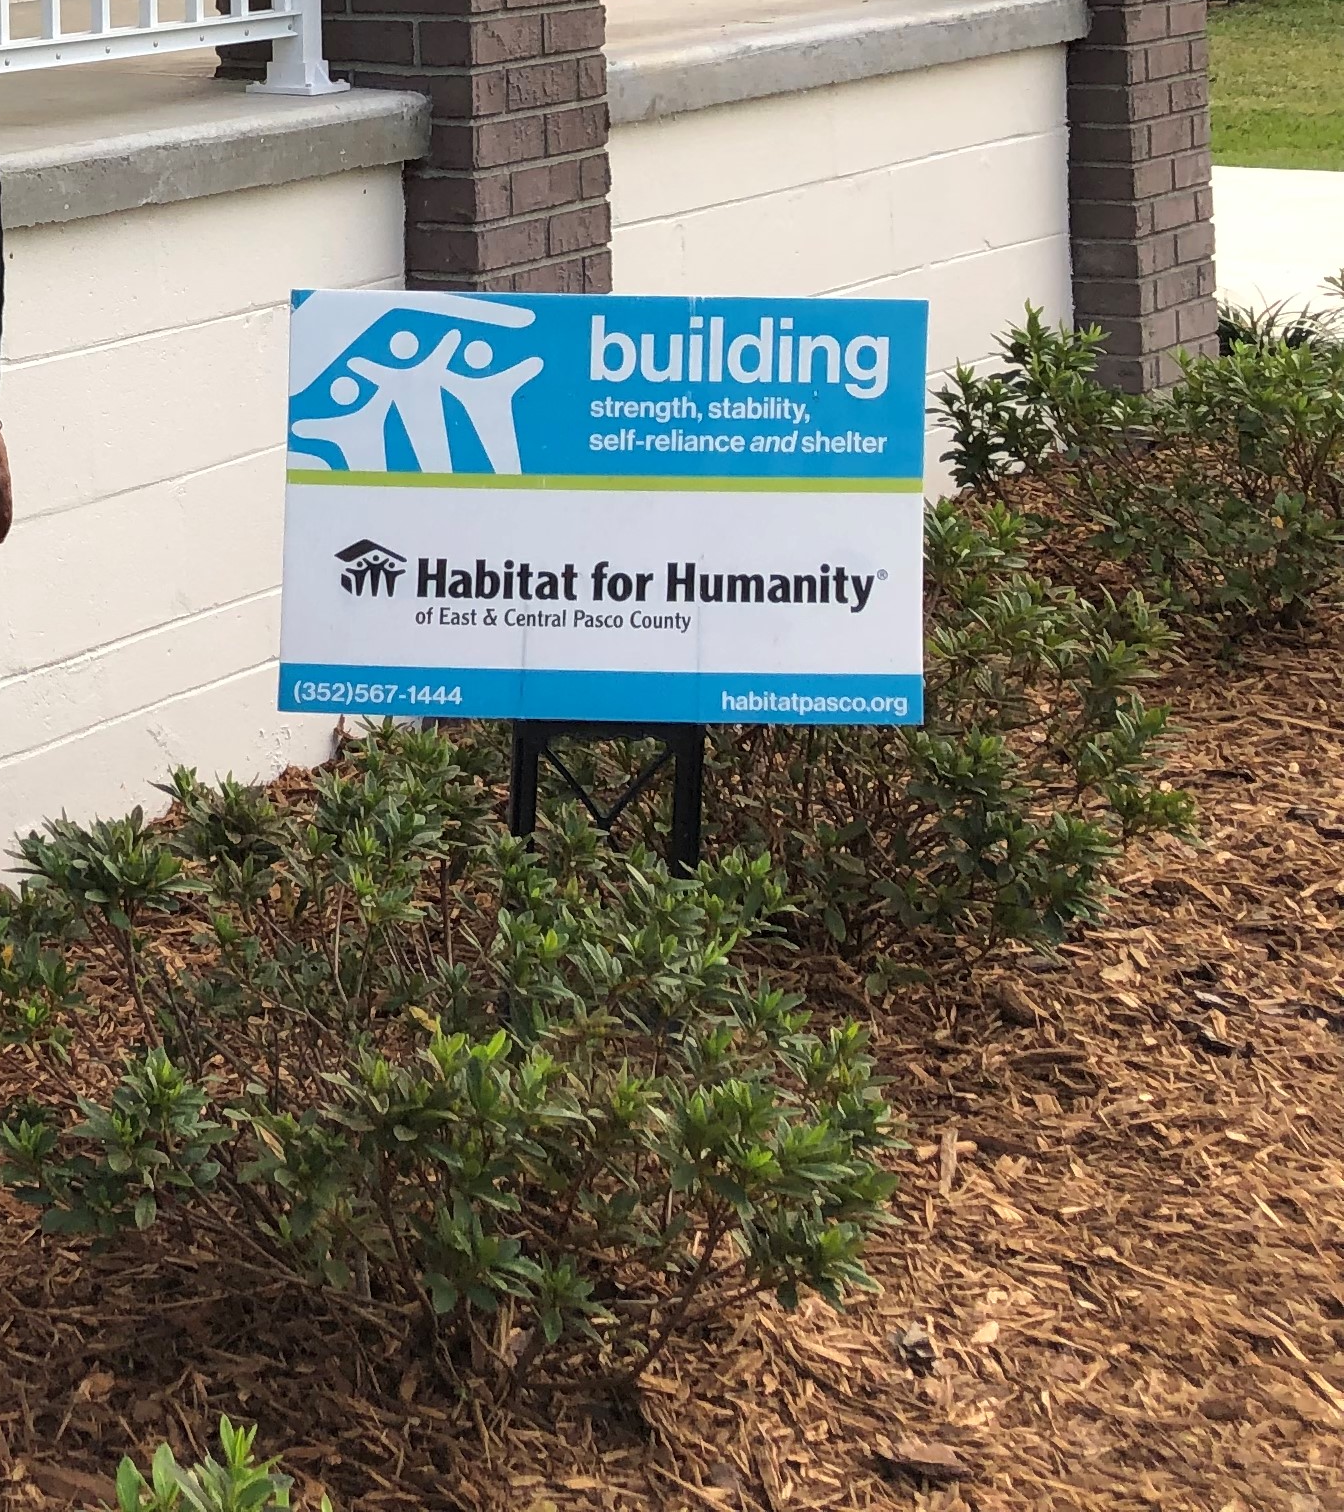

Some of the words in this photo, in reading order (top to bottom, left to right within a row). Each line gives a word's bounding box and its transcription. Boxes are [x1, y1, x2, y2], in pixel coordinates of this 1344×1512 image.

[589, 315, 890, 399] building
[589, 396, 704, 421] strength,
[708, 398, 811, 424] stability,
[589, 429, 746, 452] self-reliance
[750, 431, 797, 453] and
[801, 431, 887, 454] shelter
[416, 557, 578, 602] Habitat
[590, 561, 653, 603] for
[415, 607, 434, 626] of
[439, 608, 477, 626] East
[482, 609, 497, 627] &
[503, 609, 567, 628] Central
[573, 611, 624, 629] Pasco
[630, 612, 692, 633] County
[294, 681, 462, 705] (352)567-1444
[721, 692, 908, 716] habitatpasco.org
